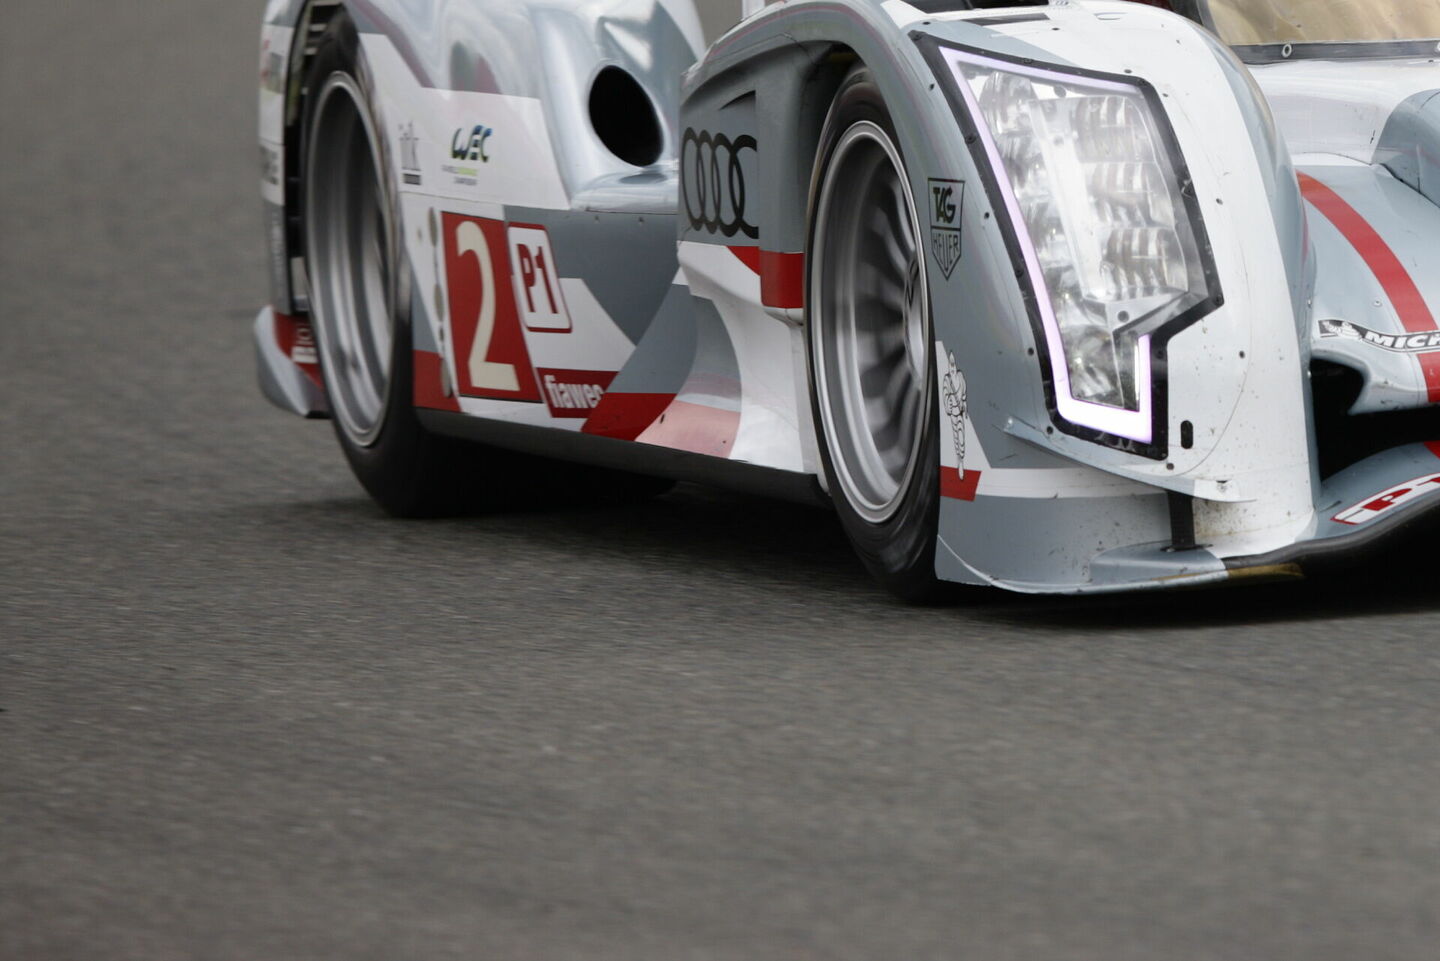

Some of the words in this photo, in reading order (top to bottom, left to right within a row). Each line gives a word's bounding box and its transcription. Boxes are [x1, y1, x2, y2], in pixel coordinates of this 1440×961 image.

[451, 125, 493, 163] WEC
[933, 185, 956, 224] TAG
[932, 231, 959, 272] HEUER
[516, 243, 560, 315] P1
[456, 220, 521, 392] 2
